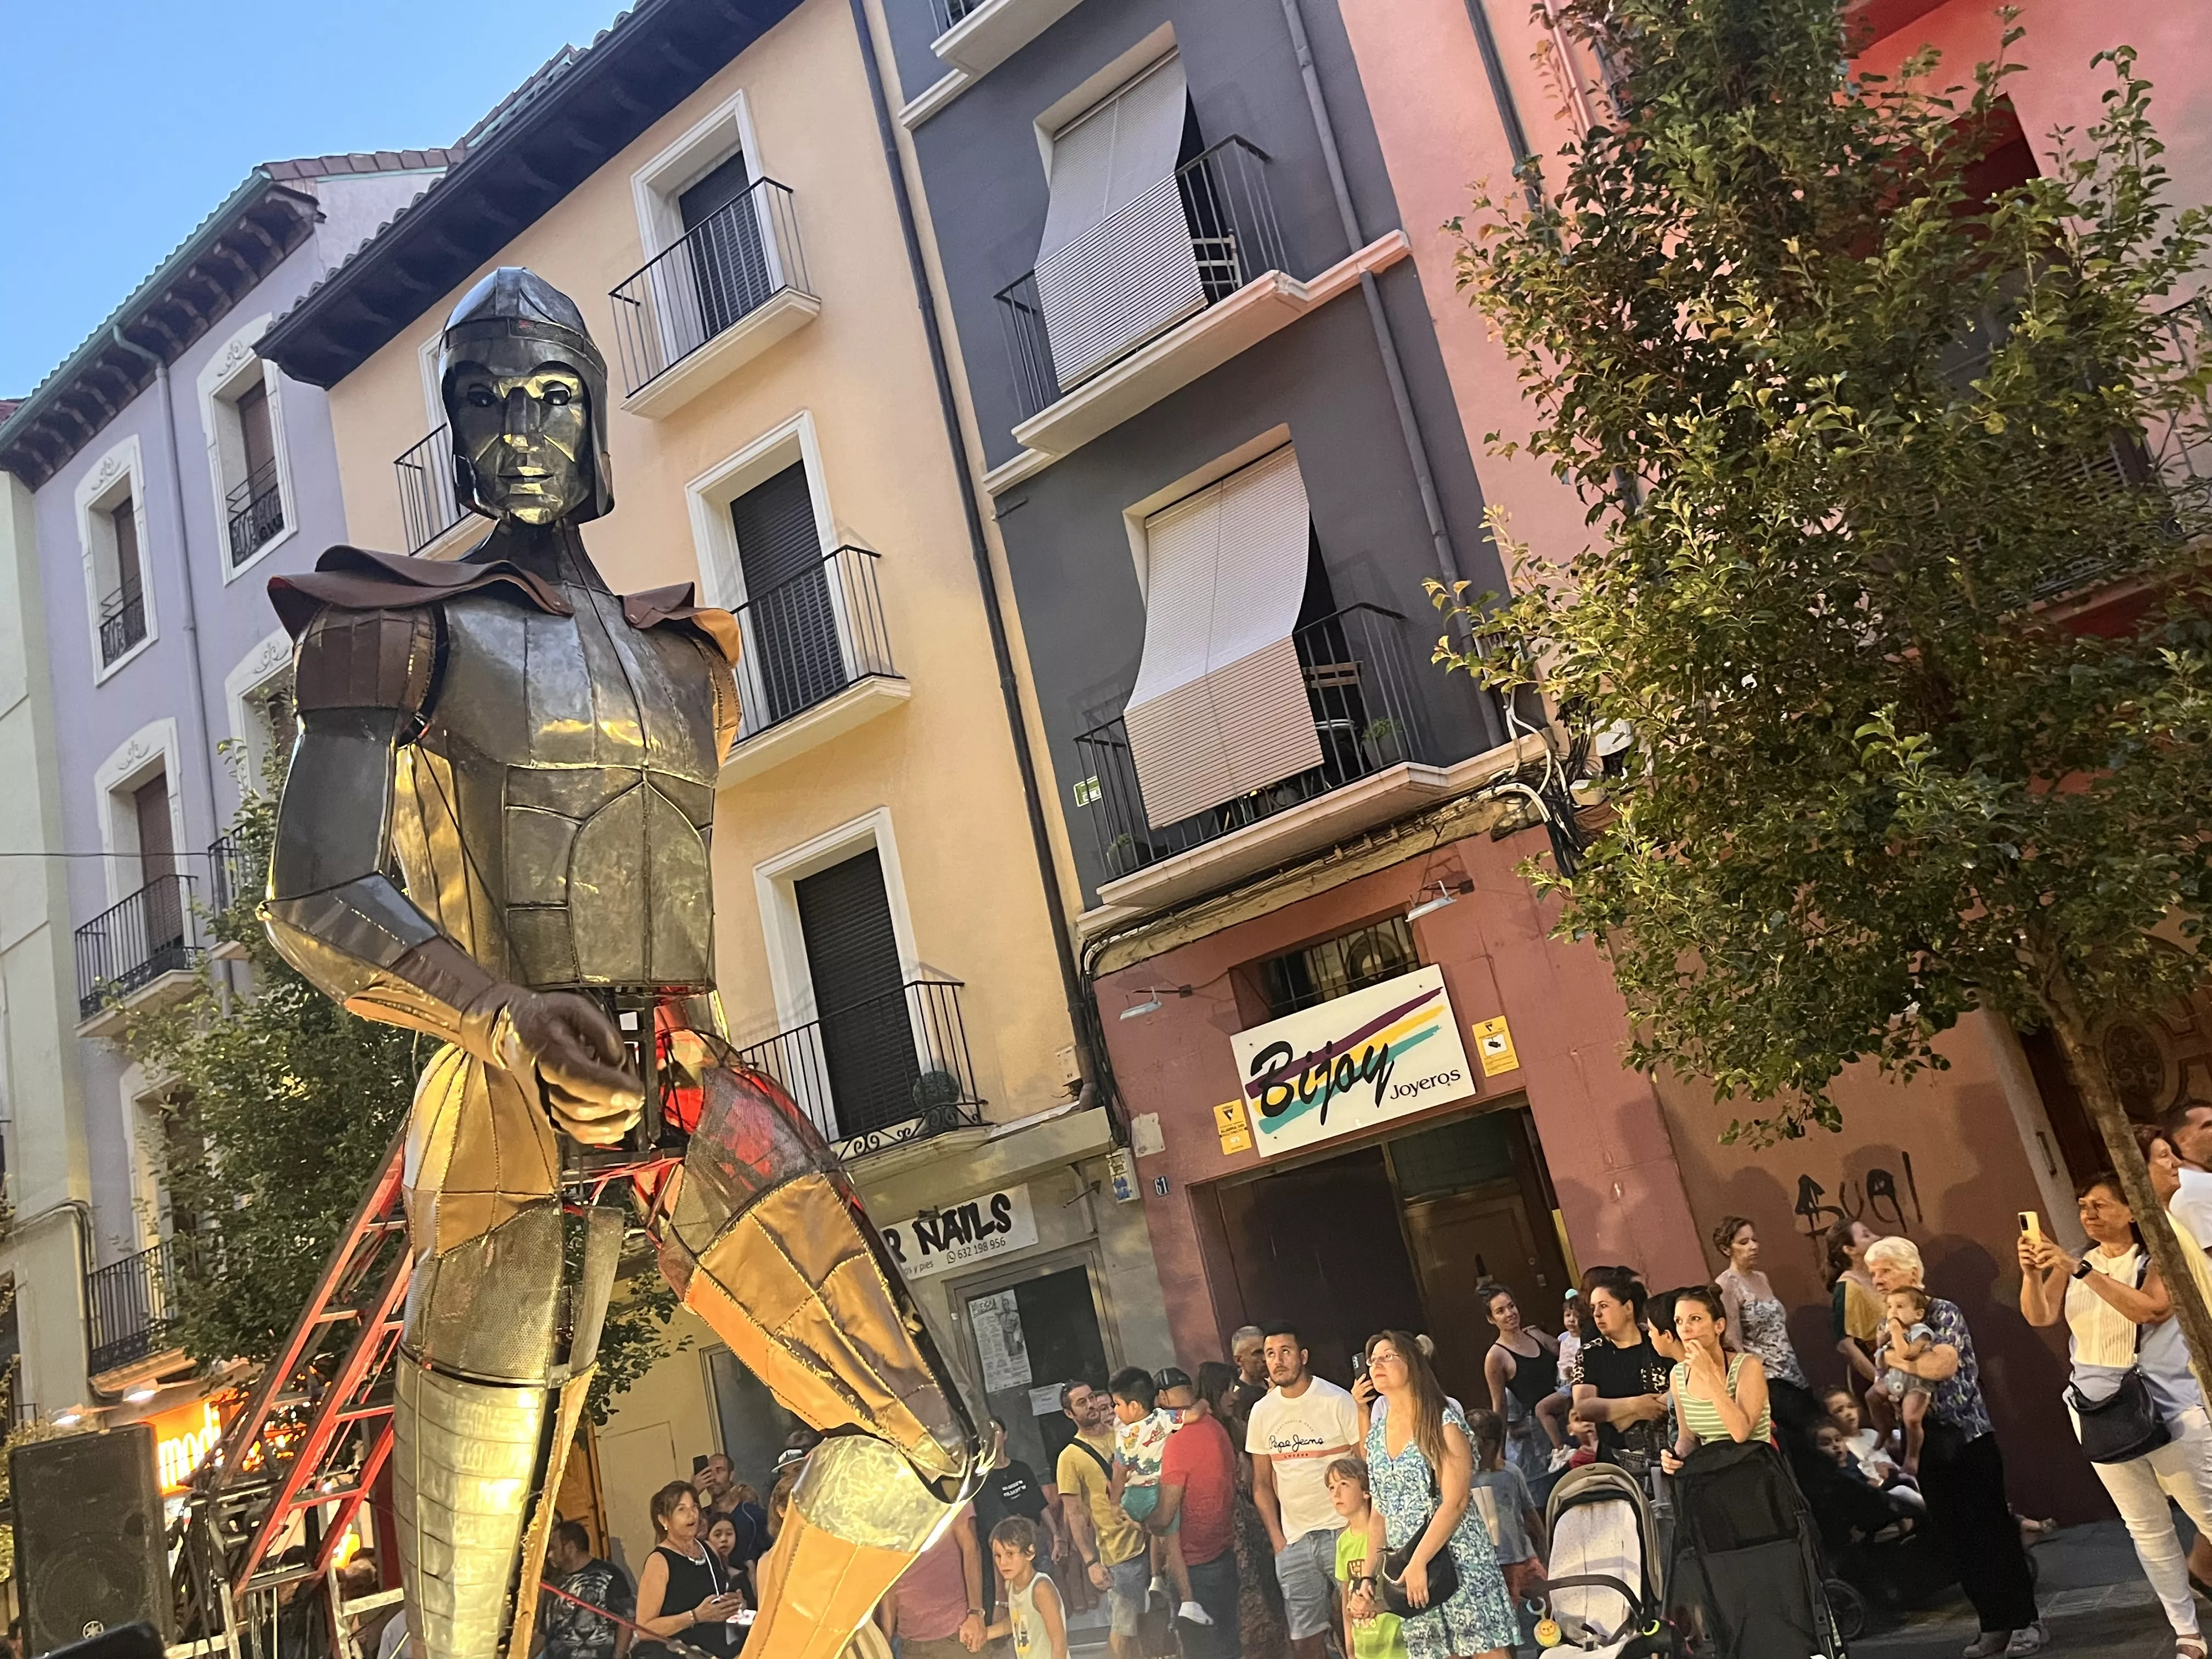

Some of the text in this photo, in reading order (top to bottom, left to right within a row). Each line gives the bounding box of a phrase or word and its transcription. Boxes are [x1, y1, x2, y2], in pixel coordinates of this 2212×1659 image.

[1250, 1041, 1394, 1126] Bijoy
[1390, 1069, 1461, 1100] Joyeros
[1154, 1177, 1167, 1195] 61
[912, 1193, 1011, 1255] NAILS
[957, 1237, 1006, 1259] 632 198 956
[1269, 1434, 1324, 1453] Pepe Jeans
